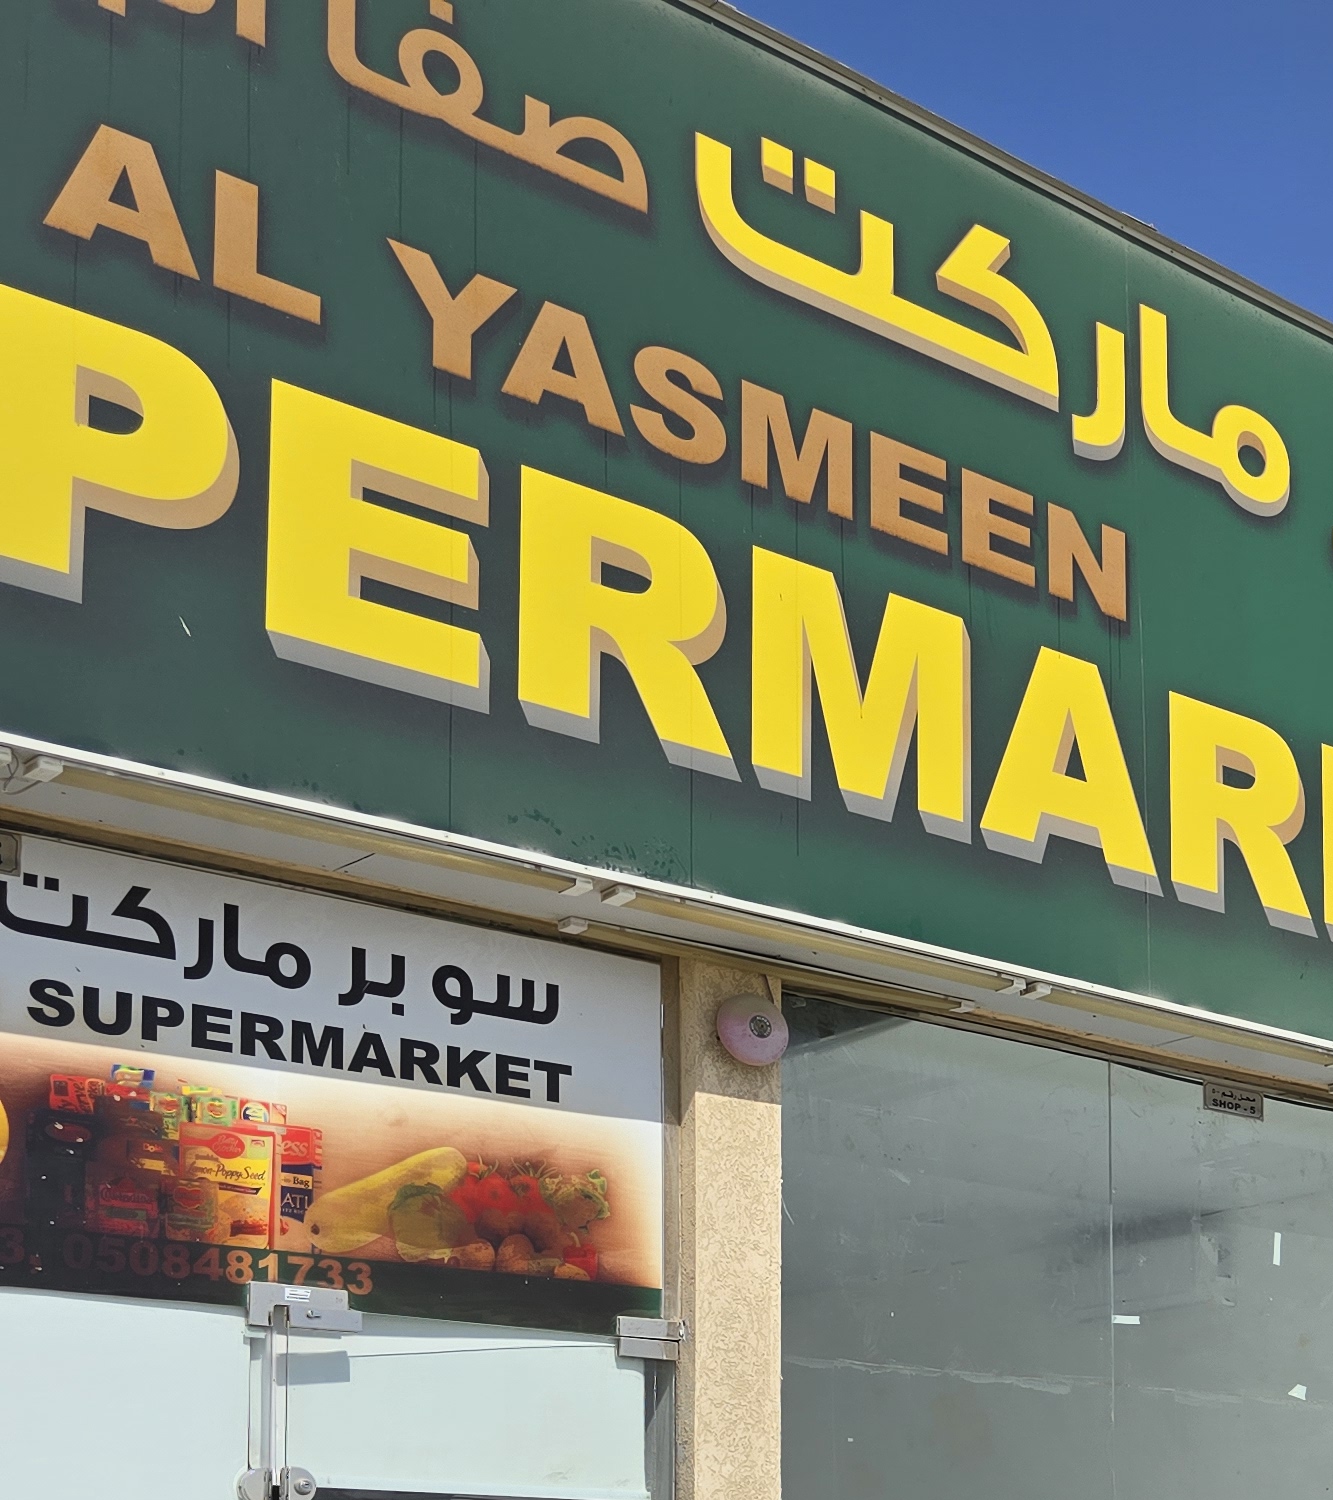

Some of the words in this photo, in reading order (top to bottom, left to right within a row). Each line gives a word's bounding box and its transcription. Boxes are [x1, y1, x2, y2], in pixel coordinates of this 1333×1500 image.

[42, 124, 321, 326] AL
[387, 238, 1126, 622] YASMEEN
[695, 131, 1290, 518] ماركت
[0, 872, 311, 989] ماركت
[339, 946, 561, 1026] سوبر
[27, 979, 573, 1102] SUPERMARKET
[1212, 1098, 1241, 1111] SHOP
